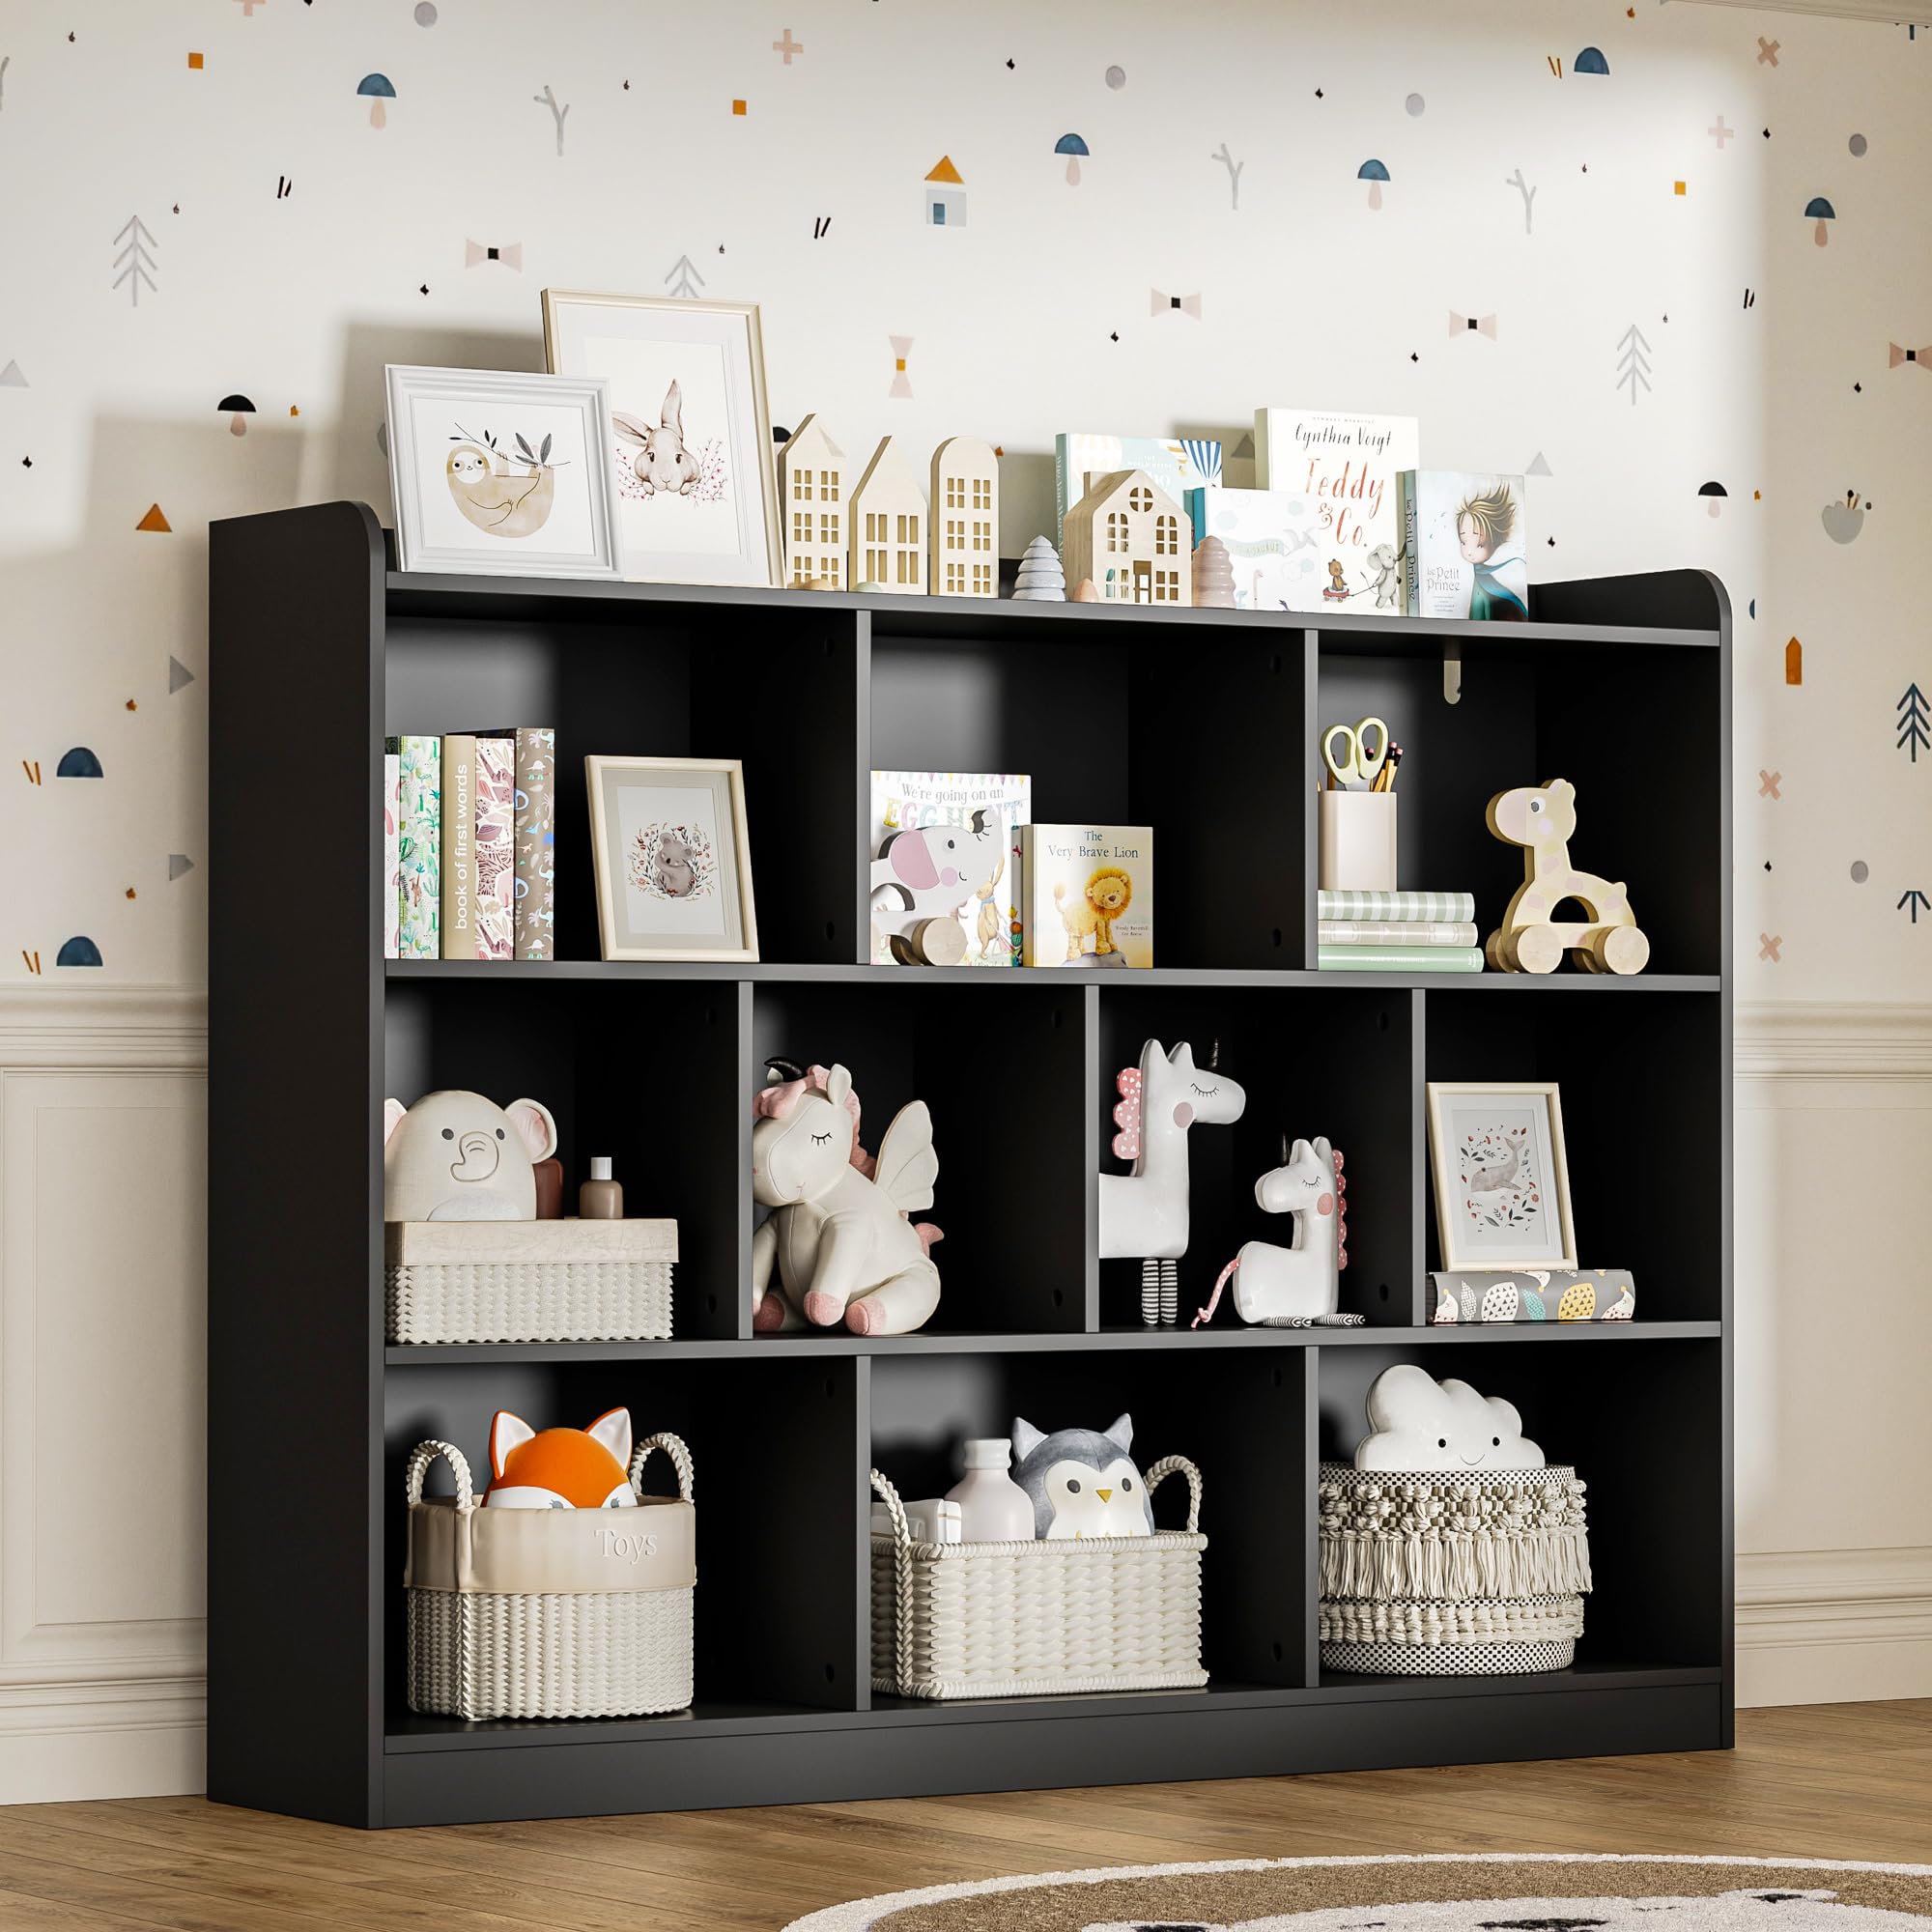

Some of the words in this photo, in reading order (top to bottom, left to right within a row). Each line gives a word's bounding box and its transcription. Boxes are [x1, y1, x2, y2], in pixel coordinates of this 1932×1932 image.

[1294, 423, 1350, 451] Cynthia
[1358, 426, 1392, 456] Voigt
[1305, 458, 1384, 520] Teddy
[1318, 502, 1333, 530] &
[1336, 506, 1368, 547] Co.
[455, 764, 468, 819] words
[901, 782, 932, 798] We're
[935, 788, 968, 805] going
[971, 788, 986, 801] on
[989, 788, 1004, 799] an
[883, 797, 937, 831] EGG
[455, 824, 468, 857] first
[1084, 831, 1103, 841] The
[1047, 845, 1073, 861] Very
[1079, 845, 1110, 858] Brave
[1114, 846, 1139, 858] Lion
[455, 860, 468, 880] of
[455, 885, 468, 929] book
[593, 1529, 658, 1566] Toys
